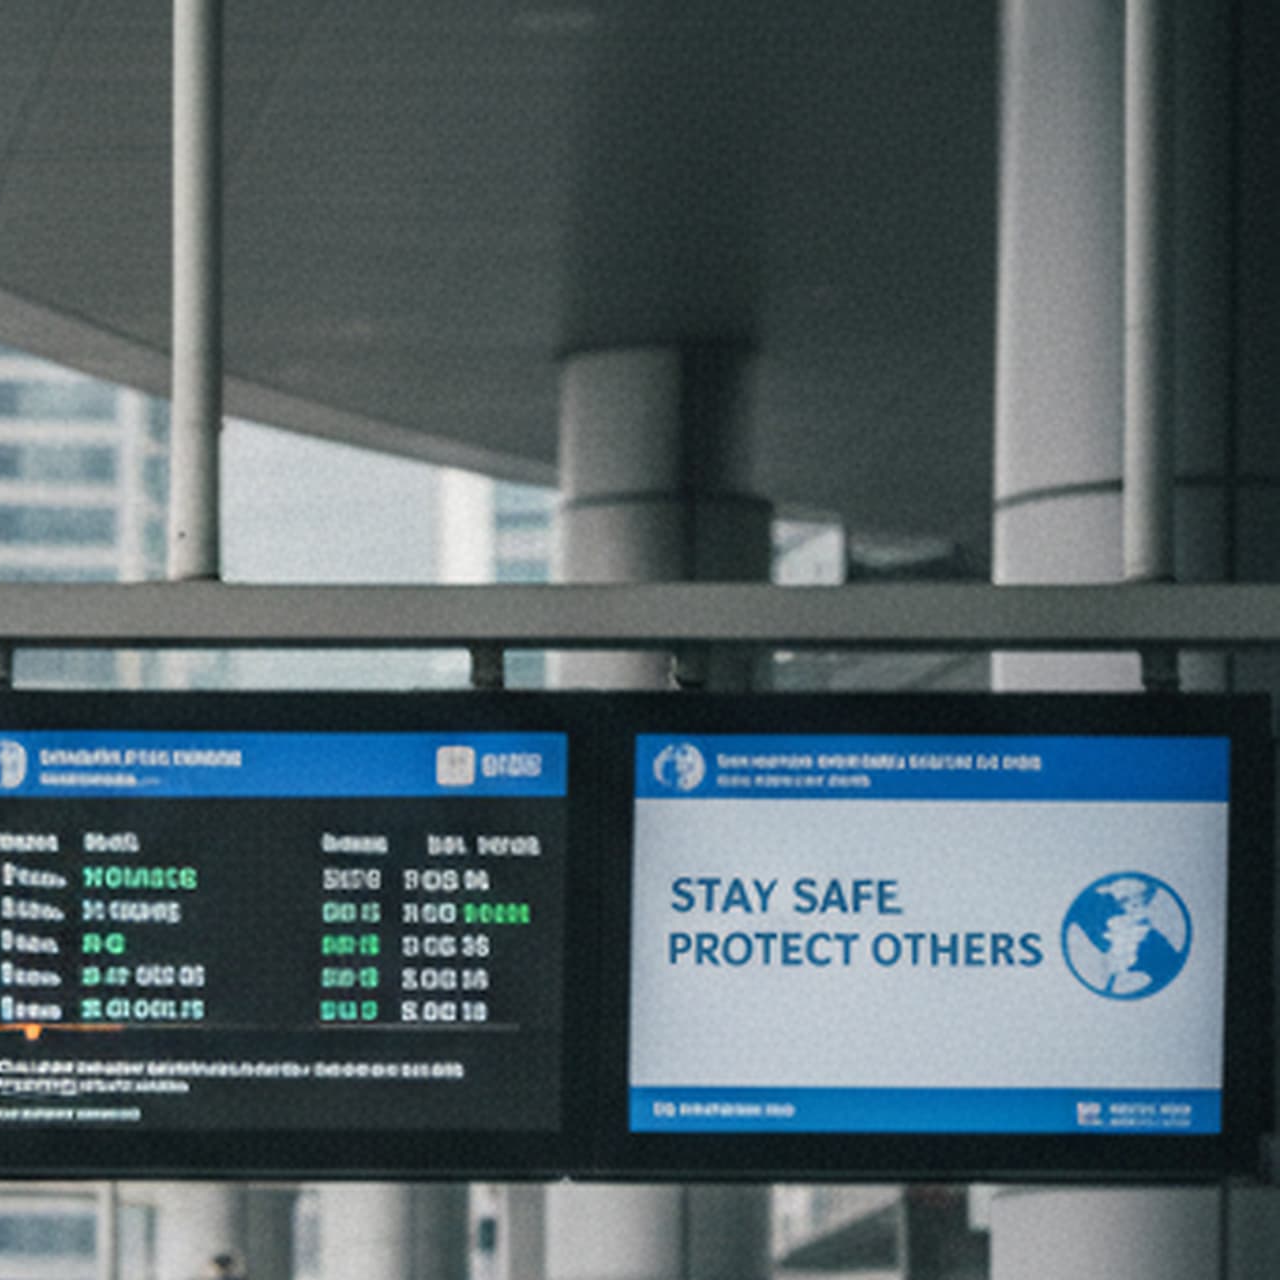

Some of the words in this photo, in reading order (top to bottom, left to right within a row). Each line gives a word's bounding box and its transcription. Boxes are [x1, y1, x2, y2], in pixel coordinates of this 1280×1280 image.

[671, 877, 778, 913] STAY
[793, 878, 903, 915] SAFE
[668, 932, 860, 966] PROTECT
[871, 932, 1044, 966] OTHERS
